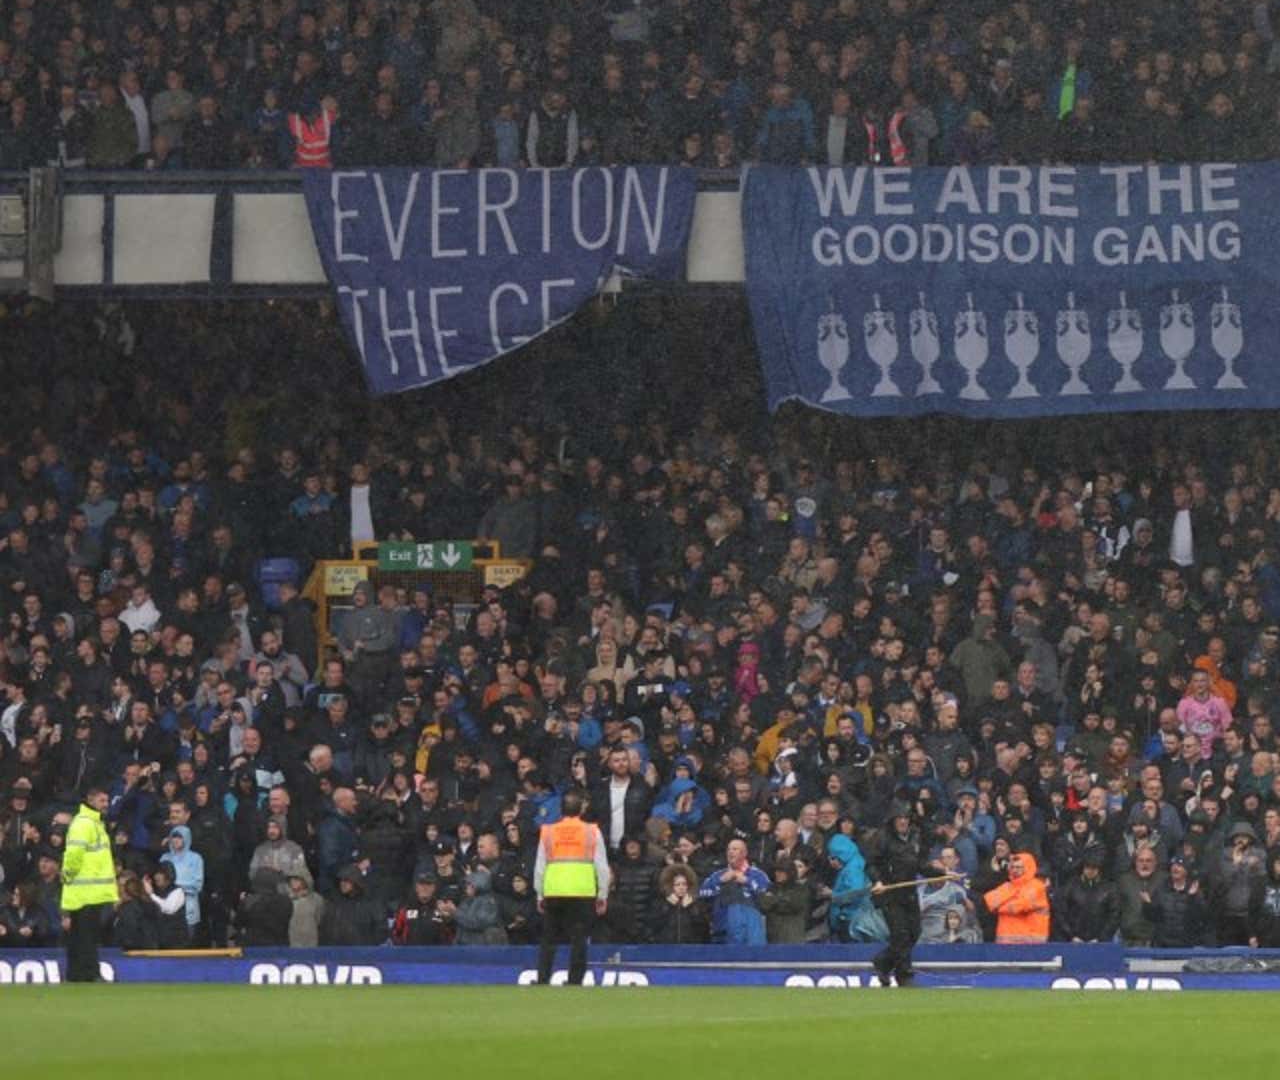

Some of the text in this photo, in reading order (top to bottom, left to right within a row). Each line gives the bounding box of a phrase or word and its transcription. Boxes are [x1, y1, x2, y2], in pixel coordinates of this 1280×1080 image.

[331, 166, 668, 263] EVERTON
[808, 163, 1240, 218] WE ARE THE
[811, 220, 1242, 266] GOODISON GANG
[337, 284, 466, 378] THE
[389, 550, 412, 562] Exit
